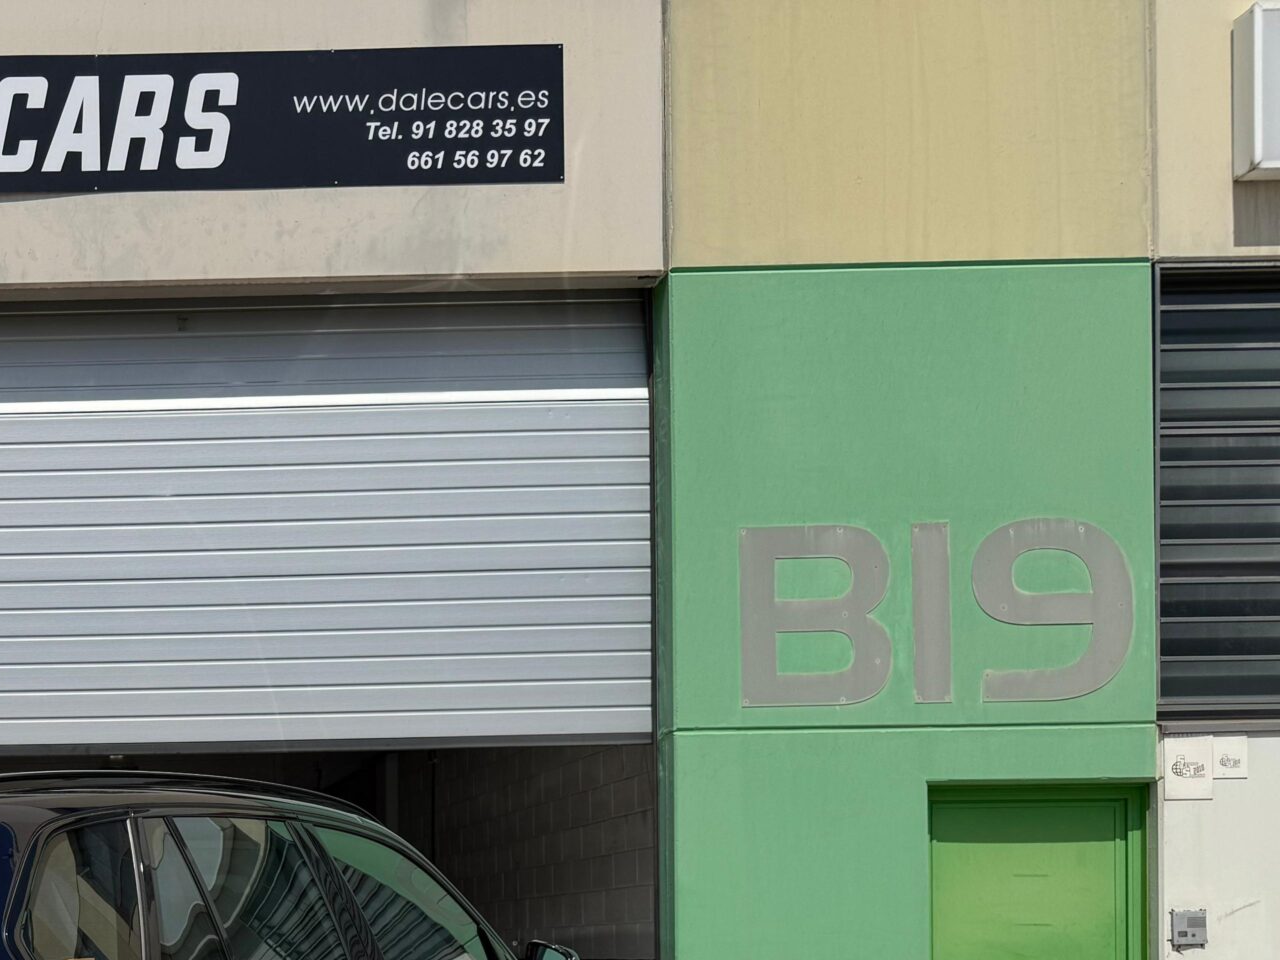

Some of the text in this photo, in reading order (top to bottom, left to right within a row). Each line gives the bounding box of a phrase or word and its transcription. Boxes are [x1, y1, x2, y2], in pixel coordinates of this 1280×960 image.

[293, 87, 550, 115] www.dalecars.es
[365, 118, 551, 141] Tel. 91 828 35 97
[406, 149, 546, 170] 661 56 97 62
[739, 516, 1134, 708] B19
